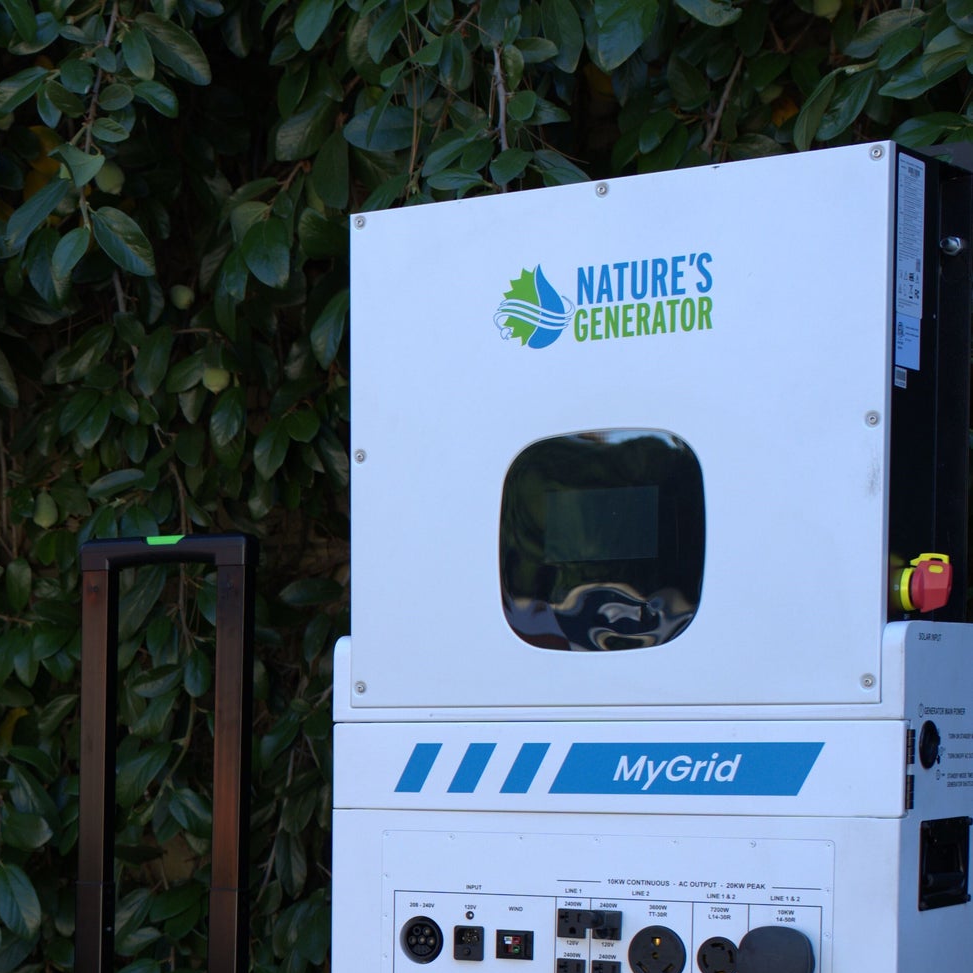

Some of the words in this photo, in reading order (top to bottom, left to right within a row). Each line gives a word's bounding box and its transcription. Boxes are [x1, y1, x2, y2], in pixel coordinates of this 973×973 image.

[577, 252, 713, 306] NATURE'S
[573, 296, 713, 343] GENERATOR
[612, 752, 742, 790] MyGrid
